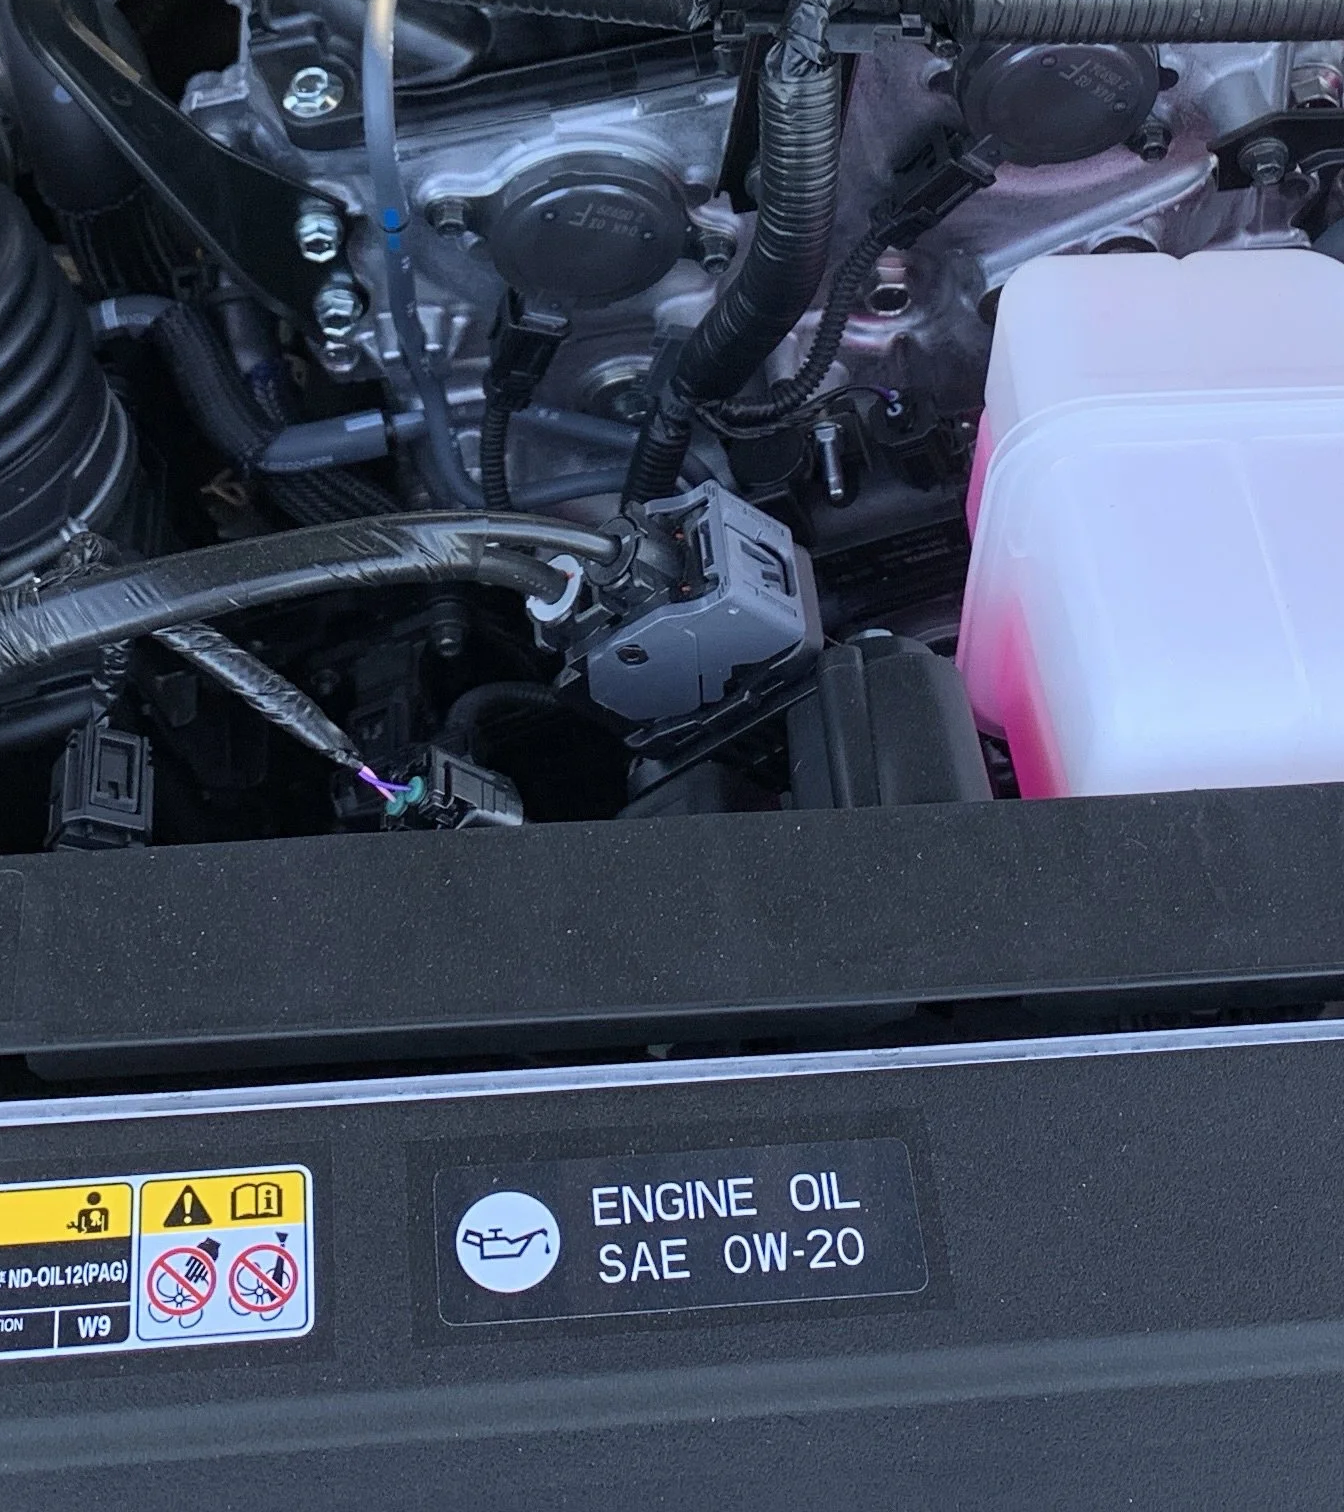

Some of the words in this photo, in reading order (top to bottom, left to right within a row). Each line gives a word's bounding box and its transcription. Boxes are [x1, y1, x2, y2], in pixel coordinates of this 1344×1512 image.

[592, 1176, 757, 1227] ENGINE
[789, 1171, 861, 1212] OIL
[7, 1259, 129, 1290] ND-OIL12(PAG)
[599, 1238, 691, 1284] SAE
[723, 1226, 866, 1275] 0W-20
[77, 1316, 112, 1339] W9
